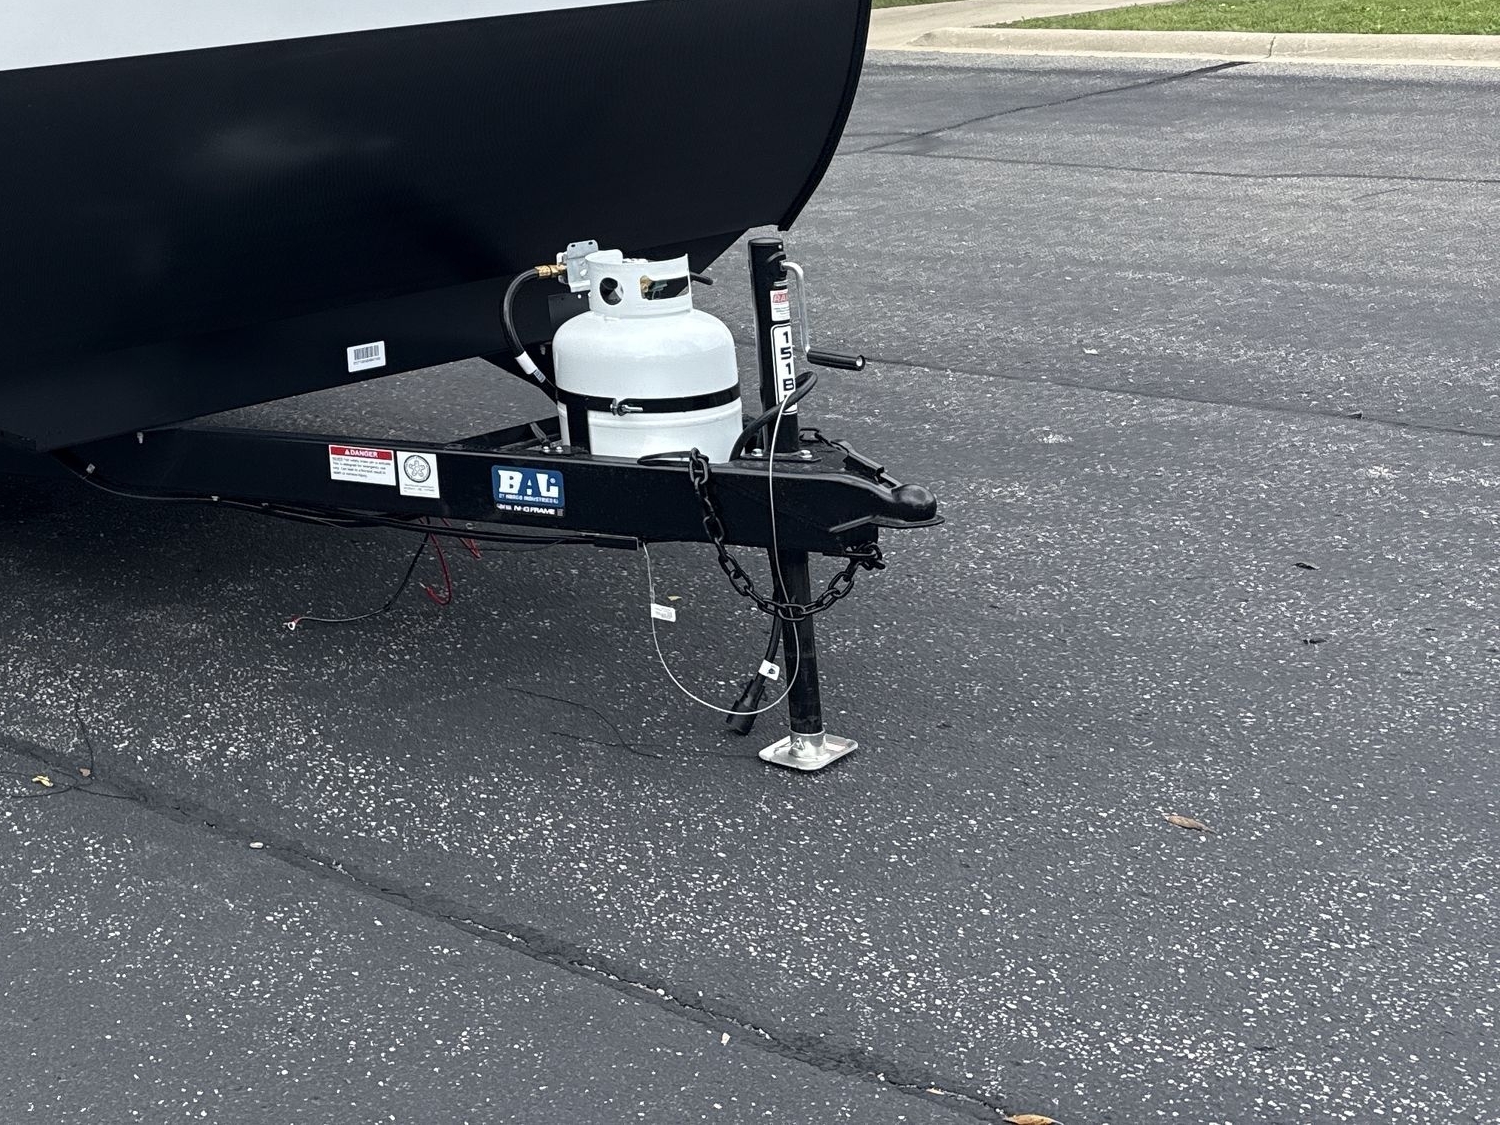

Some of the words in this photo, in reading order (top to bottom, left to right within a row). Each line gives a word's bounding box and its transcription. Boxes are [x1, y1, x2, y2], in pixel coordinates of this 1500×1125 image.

[780, 331, 797, 400] 151B
[350, 449, 379, 458] DANGER
[498, 469, 559, 498] BAL
